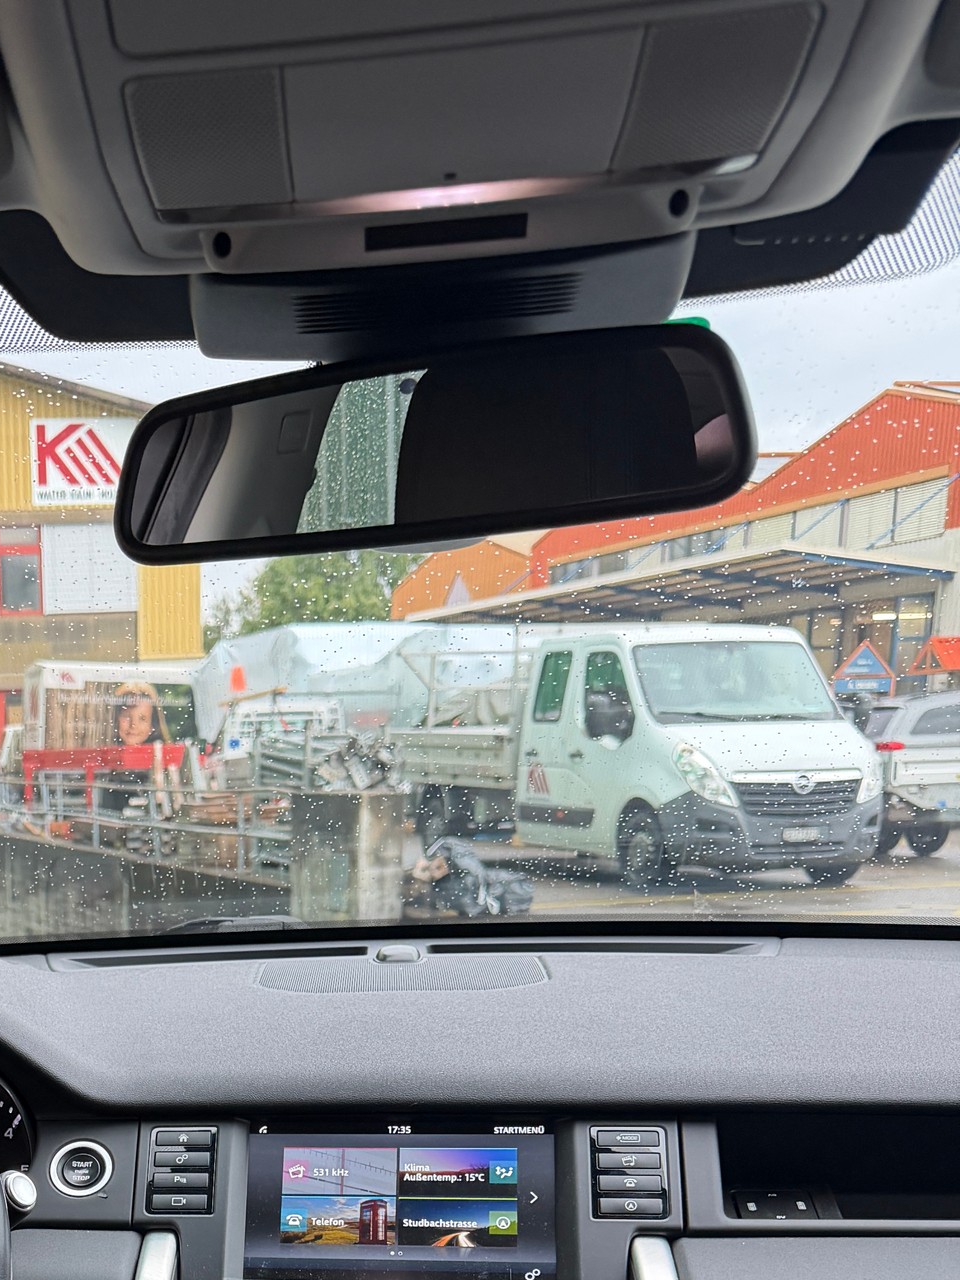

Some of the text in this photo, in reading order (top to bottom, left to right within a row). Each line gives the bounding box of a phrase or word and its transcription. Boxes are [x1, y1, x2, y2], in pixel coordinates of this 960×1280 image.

[4, 1127, 14, 1139] 4
[493, 1125, 545, 1134] STARTMENÜ
[72, 1160, 93, 1168] START
[404, 1163, 430, 1172] Klima
[313, 1168, 349, 1177] 531 kHz
[403, 1173, 485, 1183] Außentemp.: 15°C
[311, 1217, 345, 1226] Telefon
[402, 1218, 478, 1228] Studbachstrasse
